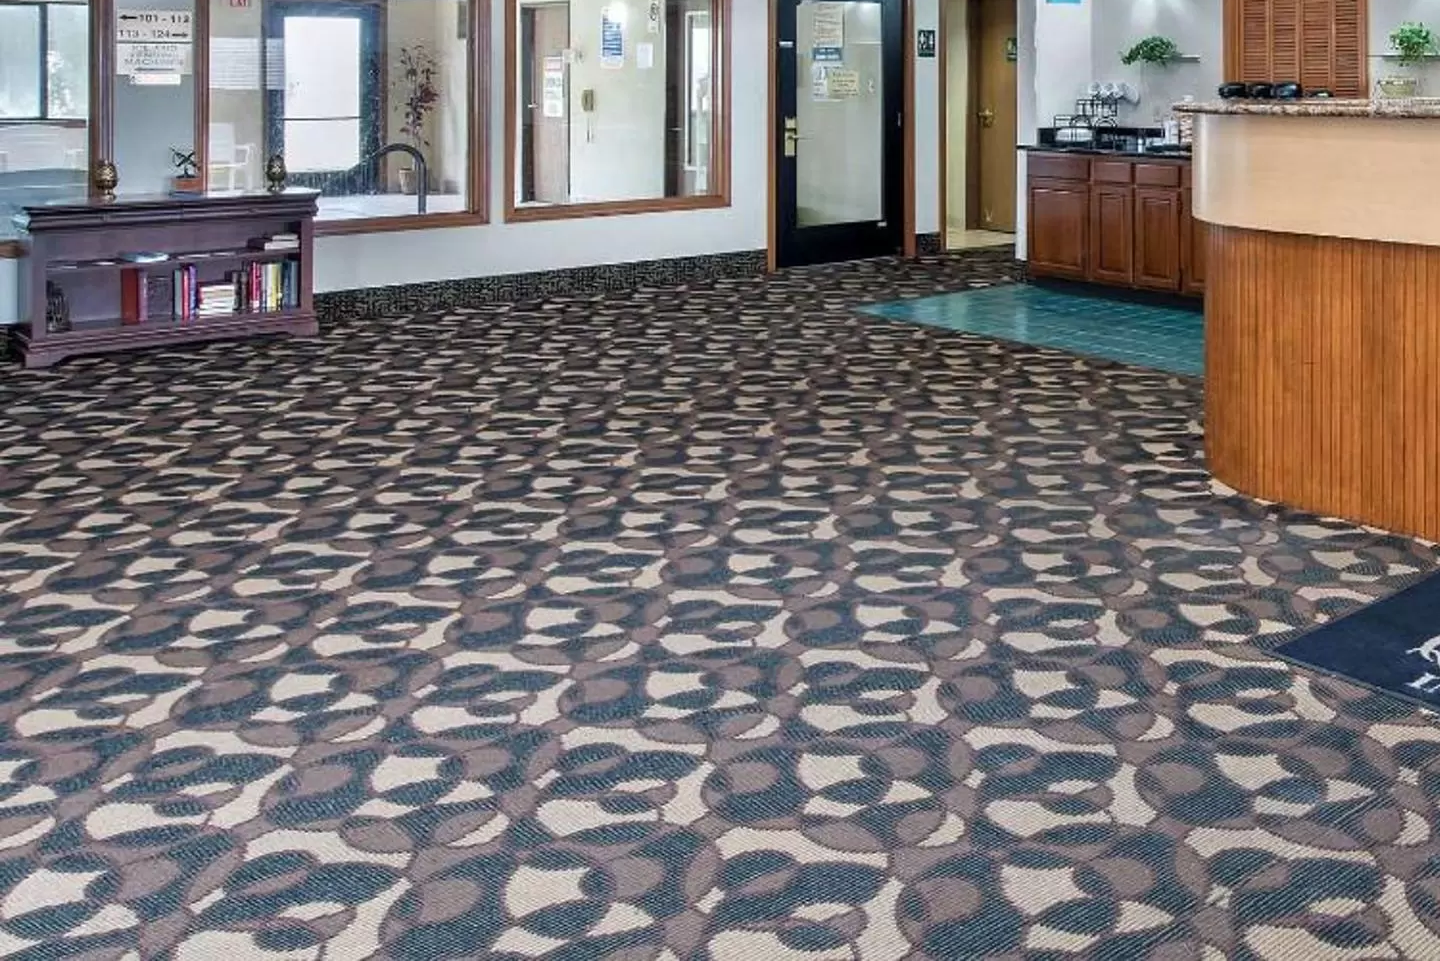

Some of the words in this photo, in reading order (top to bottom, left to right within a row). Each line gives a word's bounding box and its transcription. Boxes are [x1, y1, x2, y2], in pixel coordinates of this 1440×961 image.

[139, 14, 159, 23] 101
[171, 15, 190, 24] 112
[118, 29, 139, 38] 113
[152, 29, 170, 38] 124
